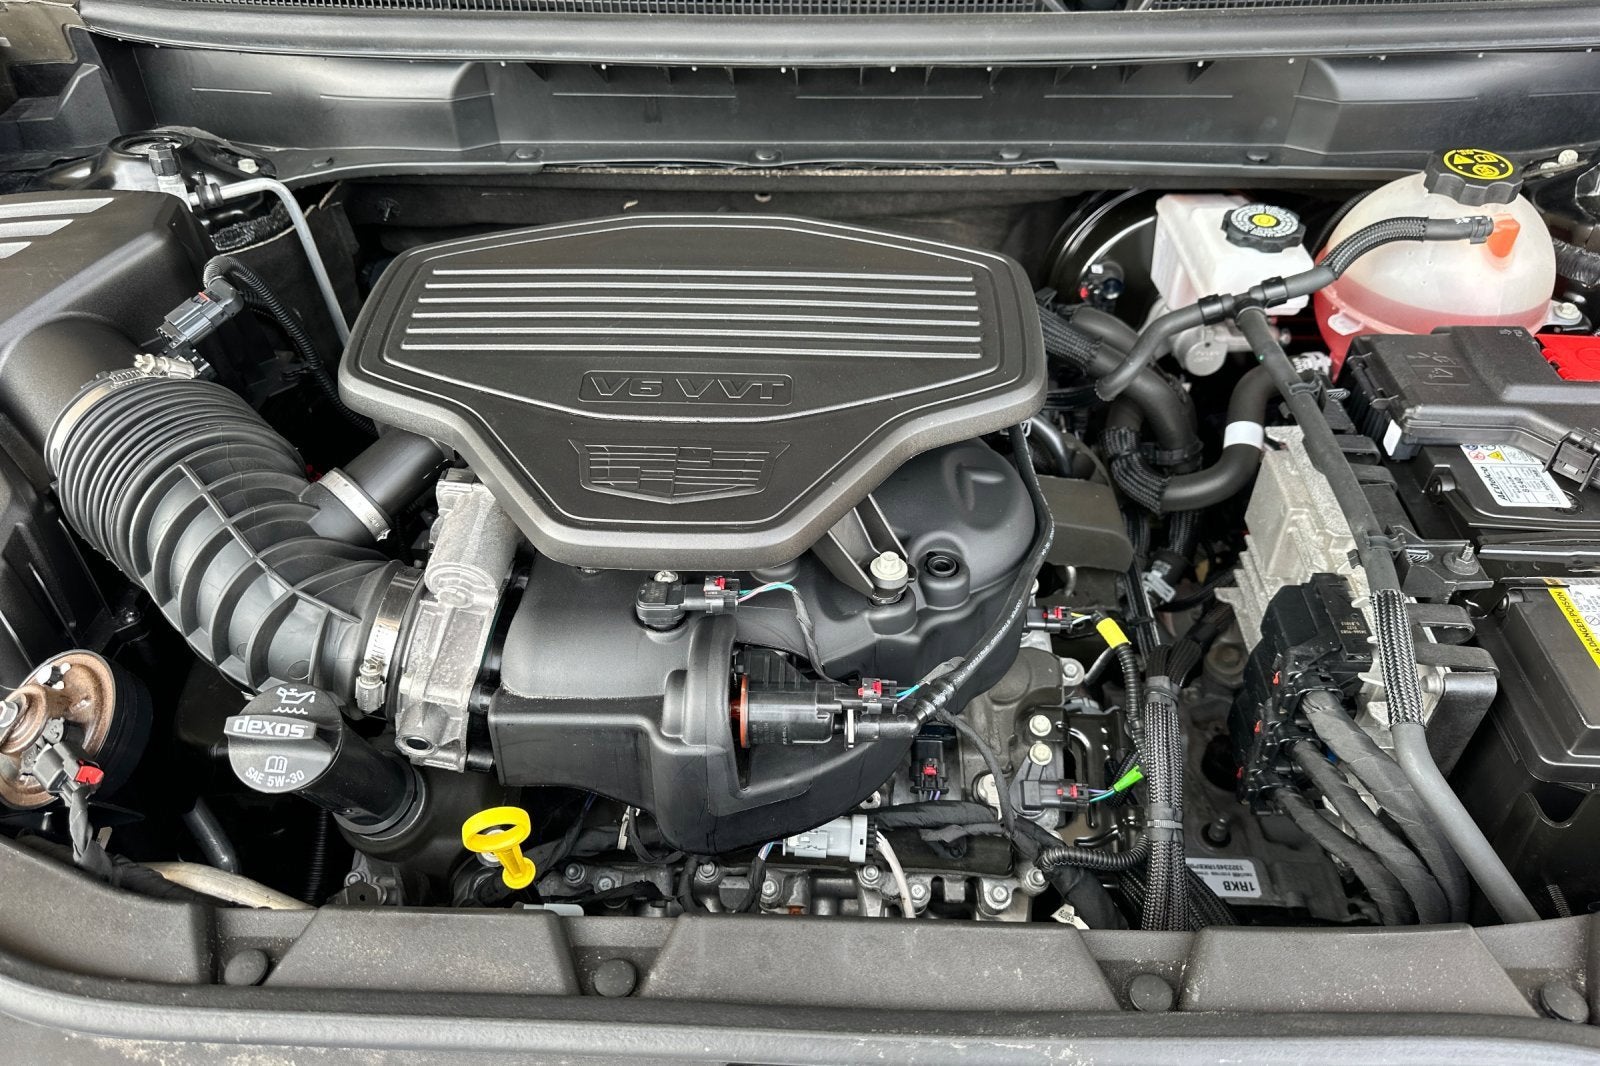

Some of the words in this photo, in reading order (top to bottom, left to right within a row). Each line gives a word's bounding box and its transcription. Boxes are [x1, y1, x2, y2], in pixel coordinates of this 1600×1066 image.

[590, 376, 663, 397] V6
[675, 378, 785, 399] VVT
[1555, 591, 1577, 617] POISON
[1574, 618, 1597, 647] DANGER
[232, 715, 305, 738] dexos
[245, 766, 265, 784] SAE
[267, 769, 305, 787] 5W-30
[1222, 881, 1256, 892] 1RKB
